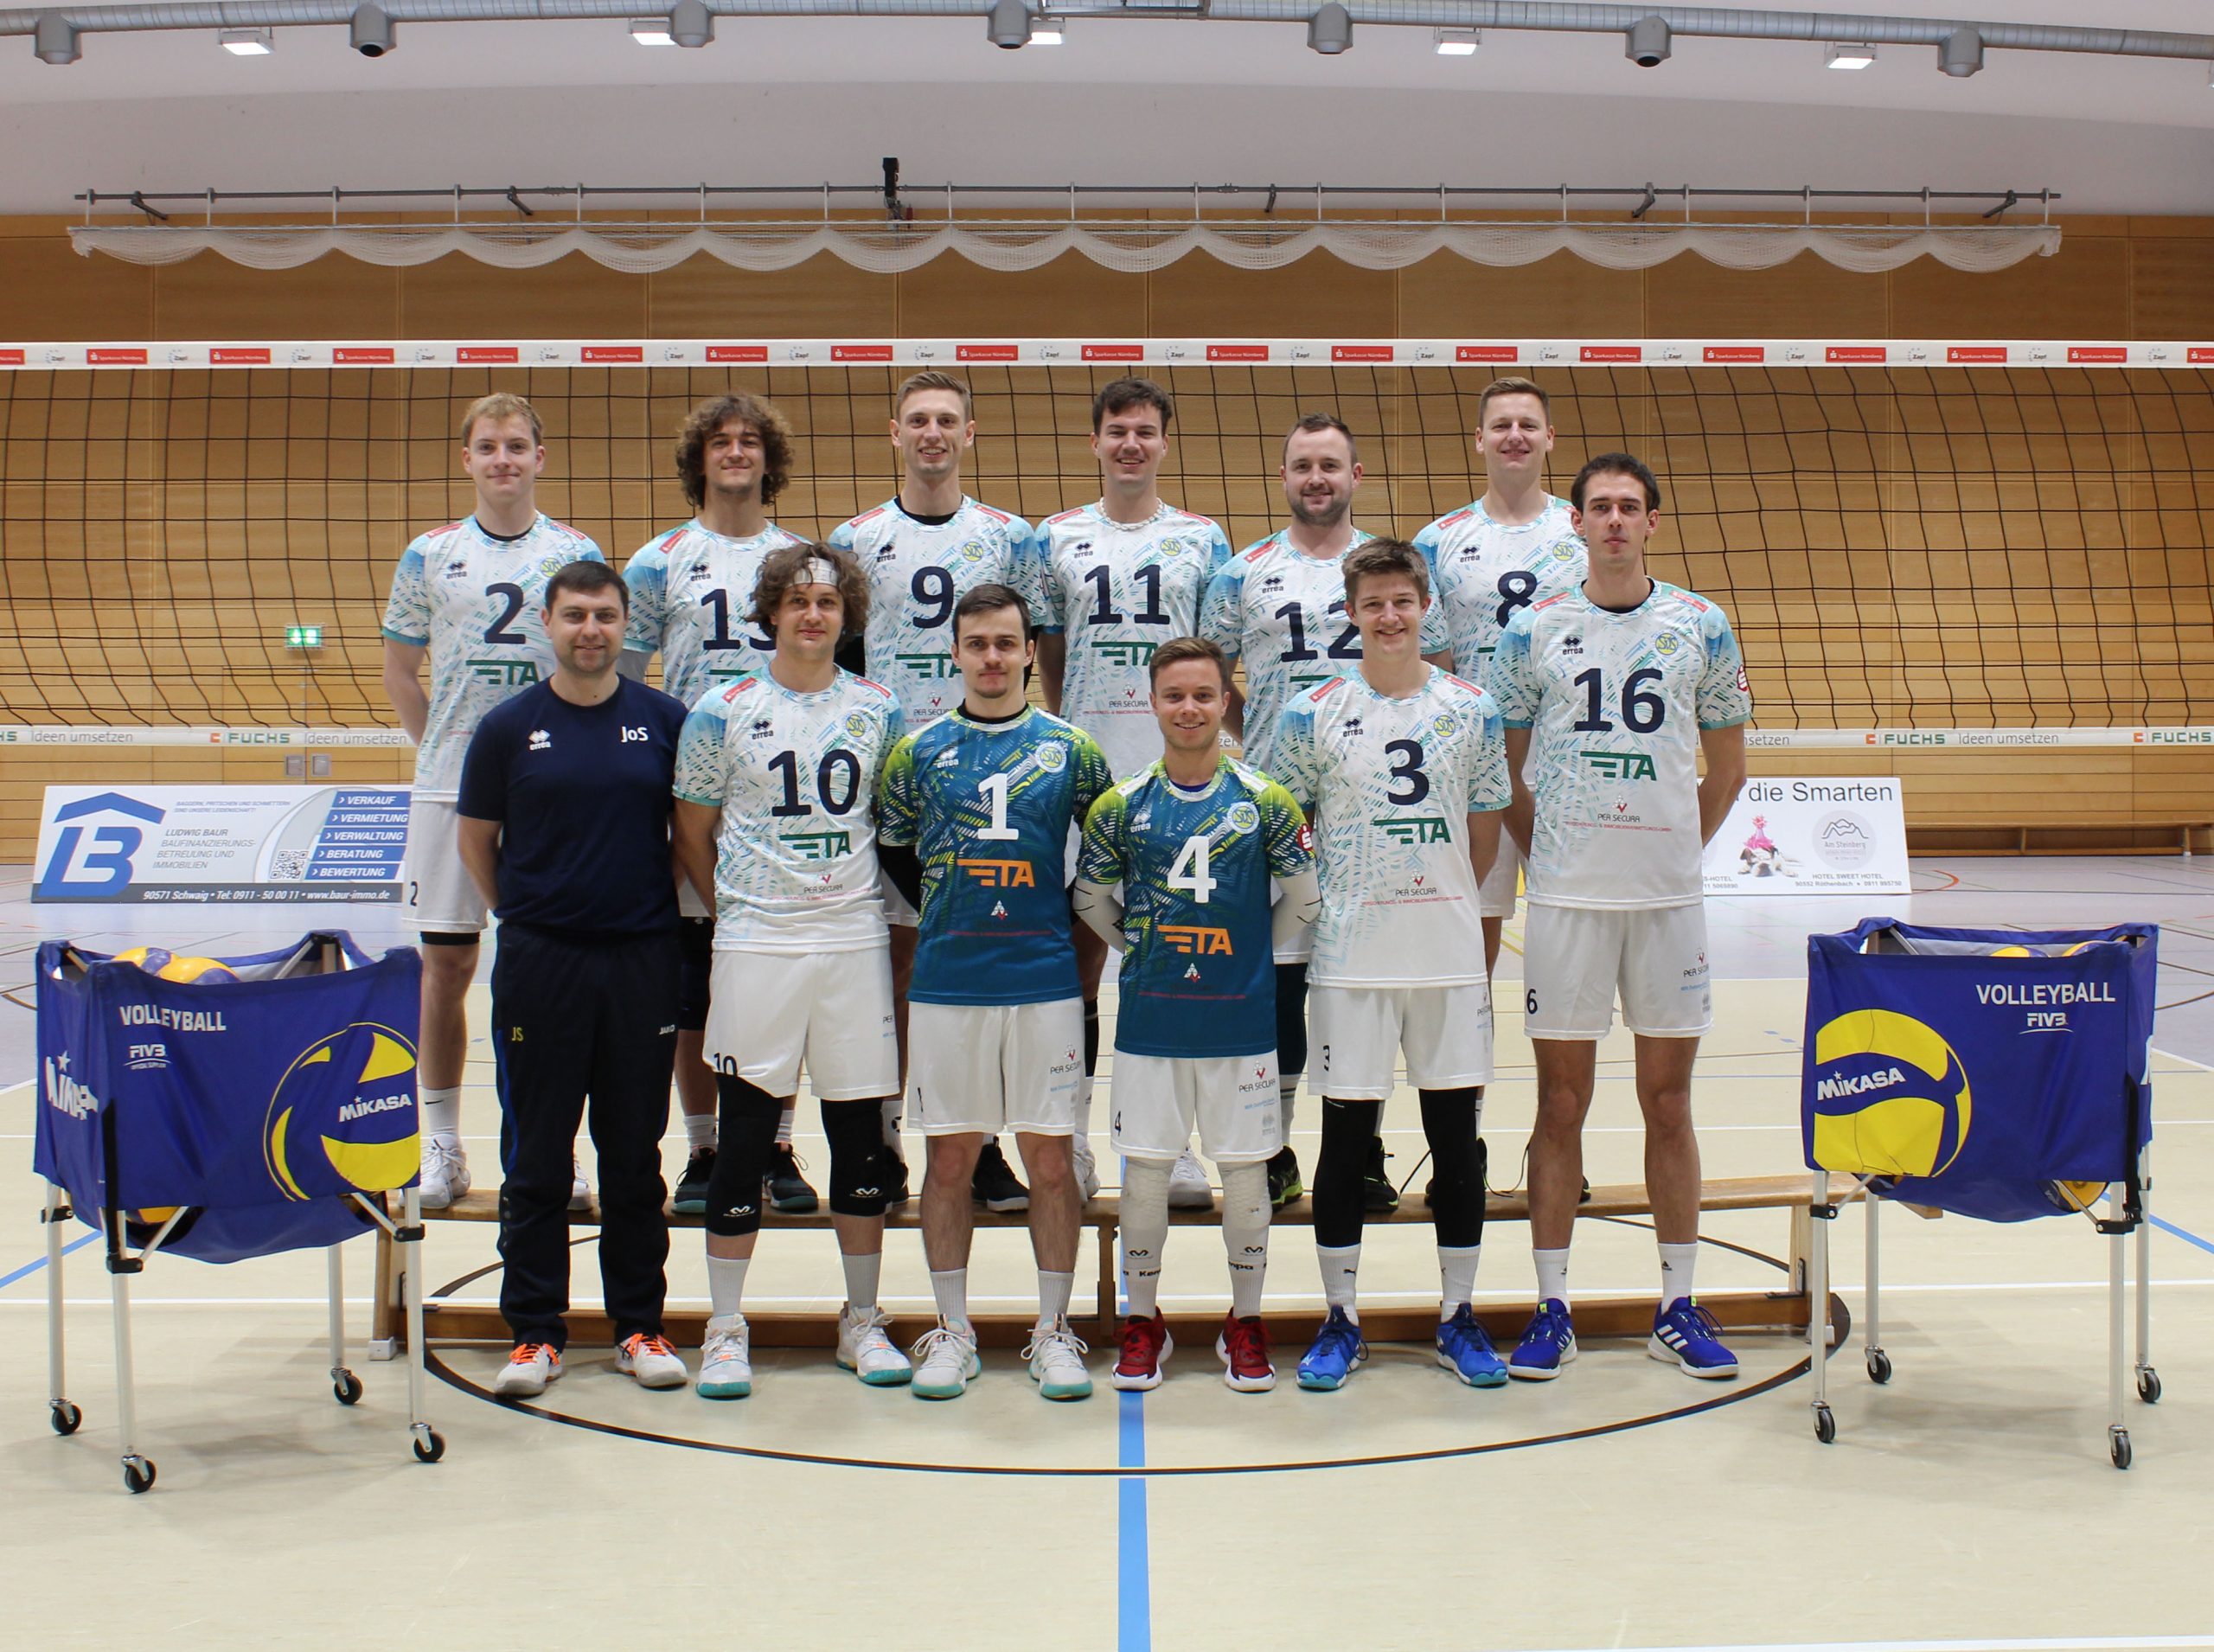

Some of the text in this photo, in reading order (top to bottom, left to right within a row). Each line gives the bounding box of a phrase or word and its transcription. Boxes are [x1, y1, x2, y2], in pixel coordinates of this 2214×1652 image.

[912, 566, 954, 629] 9
[1085, 564, 1170, 624] 11
[1496, 570, 1538, 629] 8
[484, 582, 526, 644] 2
[1275, 601, 1364, 662] 12
[466, 660, 539, 685] ETA
[1573, 668, 1665, 733] 16
[31, 731, 66, 743] Ideen
[69, 732, 133, 743] umsetzen
[228, 733, 406, 745] FUCHS Ideen umsetzen
[621, 727, 649, 743] JoS
[1884, 733, 2059, 745] FUCHS Ideen umsetzen
[2152, 732, 2211, 743] FUCHS
[1385, 739, 1430, 805] 3
[1580, 751, 1657, 781] ETA
[768, 749, 861, 816] 10
[1749, 782, 1782, 801] die
[1793, 782, 1892, 801] Smarten
[348, 796, 397, 804] VERKAUF
[977, 772, 1019, 840] 1
[341, 814, 409, 823] VERMIETUNG
[1373, 817, 1451, 844] ETA
[1613, 814, 1640, 823] SECURA
[334, 832, 404, 841] VERWALTUNG
[780, 831, 854, 859] ETA
[326, 850, 383, 859] BERATUNG
[319, 868, 386, 877] BEWERTUNG
[957, 859, 1035, 887] ETA
[1168, 836, 1217, 904] 4
[143, 890, 170, 900] 90571
[171, 890, 208, 902] Schwaig
[233, 890, 255, 900] 0911
[262, 890, 274, 900] 50
[275, 890, 287, 900] 00
[289, 890, 300, 900] 11
[307, 890, 390, 900] www.baur-immo.de
[410, 881, 419, 906] 2
[818, 884, 843, 893] SECURA
[1411, 887, 1437, 896] SECURA
[1157, 925, 1232, 955] ETA
[1975, 982, 2115, 1006] VOLLEYBALL
[119, 1004, 227, 1032] VOLLEYBALL
[512, 1027, 523, 1041] JS
[1323, 1045, 1330, 1072] 3
[1238, 1081, 1253, 1092] PER
[1816, 1066, 1906, 1101] MIKASA
[338, 1092, 413, 1123] MIKASA
[1139, 1267, 1161, 1277] Kem
[1229, 1262, 1254, 1271] mpa
